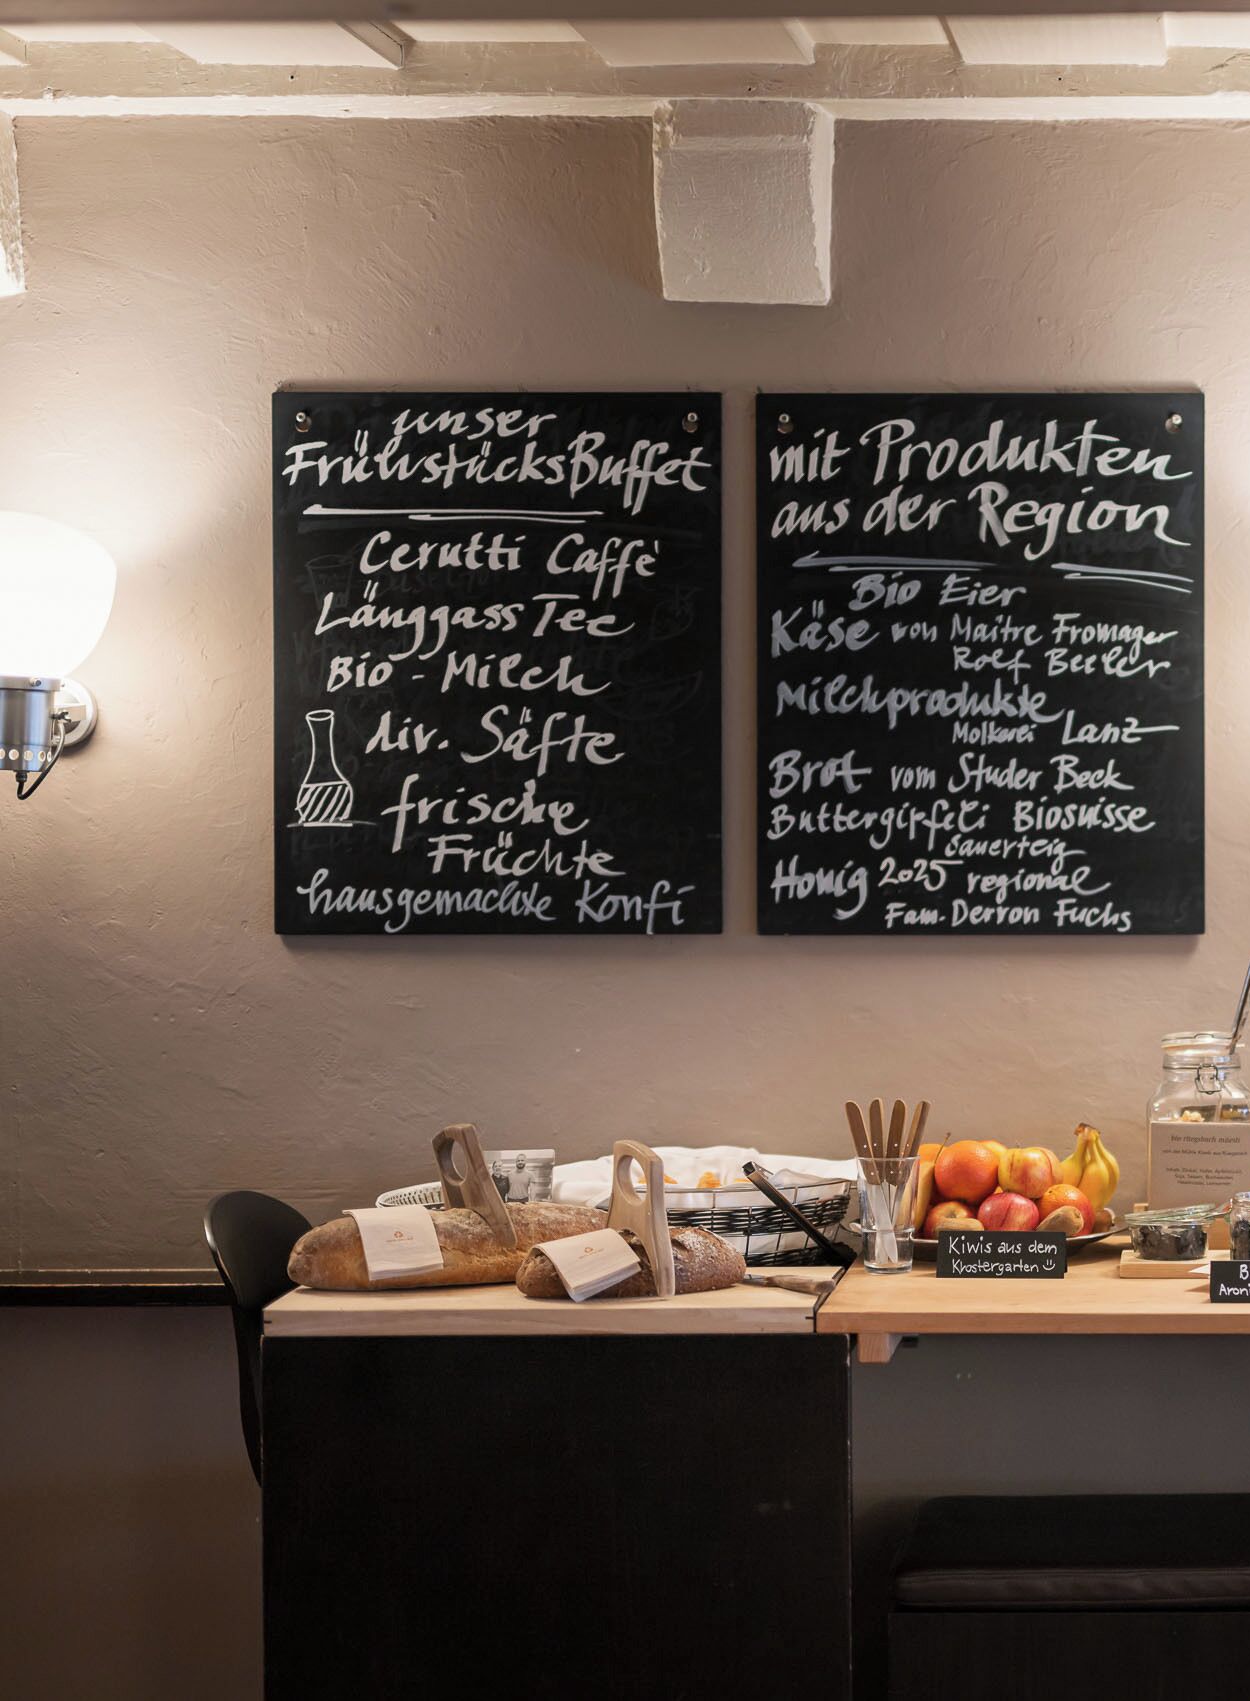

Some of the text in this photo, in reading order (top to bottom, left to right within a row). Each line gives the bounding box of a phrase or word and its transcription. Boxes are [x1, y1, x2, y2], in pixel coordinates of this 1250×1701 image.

[393, 408, 557, 440] unser
[770, 418, 1193, 486] mit Produkten
[771, 480, 1191, 561] aus der Region
[360, 531, 526, 574] Cerutti
[848, 572, 1026, 611] Bio Eier
[315, 581, 524, 660] Länggass
[532, 593, 635, 637] Tee
[771, 601, 881, 659] Käse
[891, 624, 937, 644] von
[1052, 613, 1178, 664] Fromager
[953, 647, 1031, 684] Rolf
[776, 674, 1066, 729] Milchprodukte
[952, 710, 1180, 745] Molkerei Lanz
[365, 704, 625, 777] div. Säfte
[769, 750, 1135, 799] Brot vom Studer Beck
[380, 774, 589, 853] frische
[767, 796, 1156, 851] Buttergipfeli Biosuisse
[427, 831, 626, 880] Früchte
[297, 869, 696, 934] hausgemachte Konfi
[771, 855, 1112, 921] Honig 2025 regional
[951, 899, 1040, 928] Derron
[1053, 899, 1132, 932] Fuchs
[948, 1235, 1057, 1255] Kiwis aus dem
[952, 1258, 1039, 1276] Klostergarten
